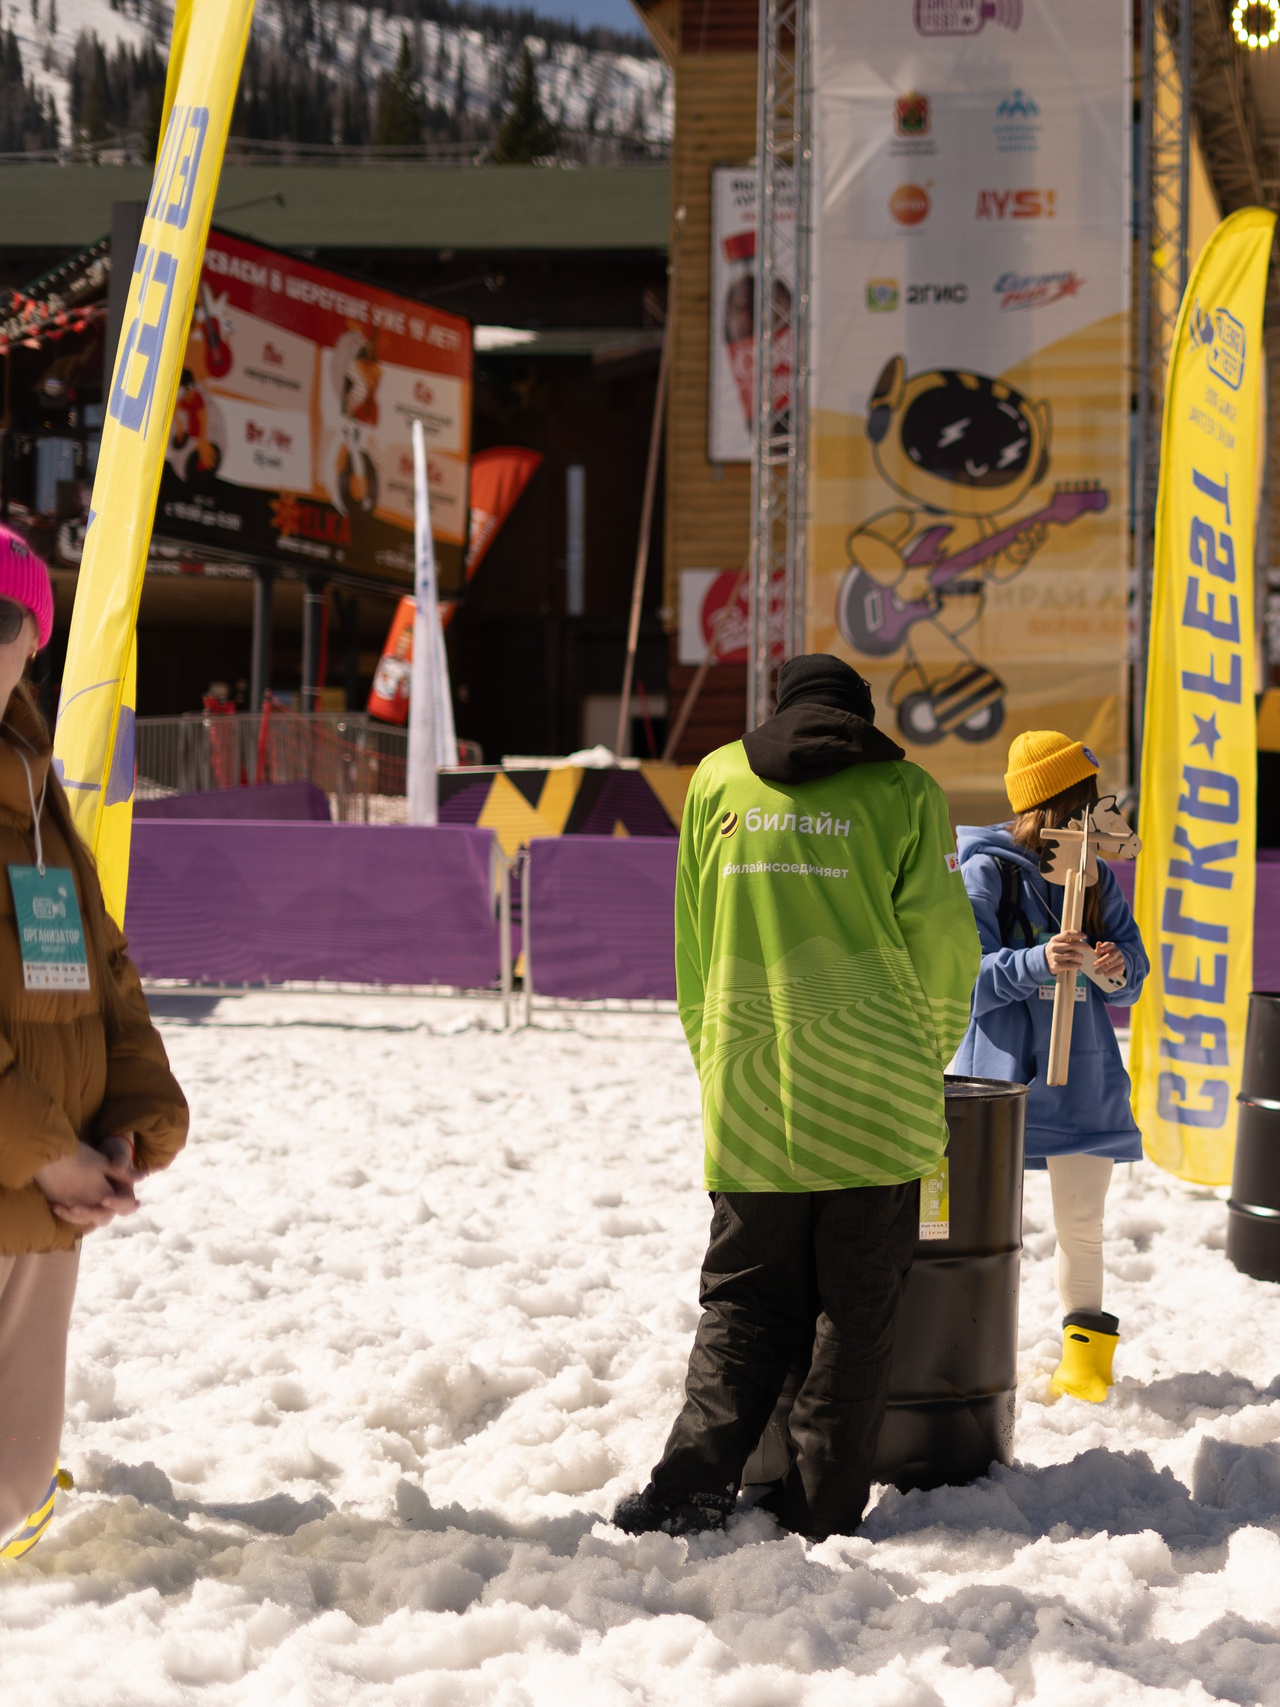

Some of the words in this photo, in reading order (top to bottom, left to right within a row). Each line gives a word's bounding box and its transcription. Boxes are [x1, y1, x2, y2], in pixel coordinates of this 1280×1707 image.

[976, 188, 1057, 220] AYS!
[285, 275, 370, 323] ШЕРЕГЕШЕ
[906, 283, 969, 306] 2ГИС
[745, 807, 851, 837] билайн
[23, 927, 80, 945] ОРГАНИЗАТОР
